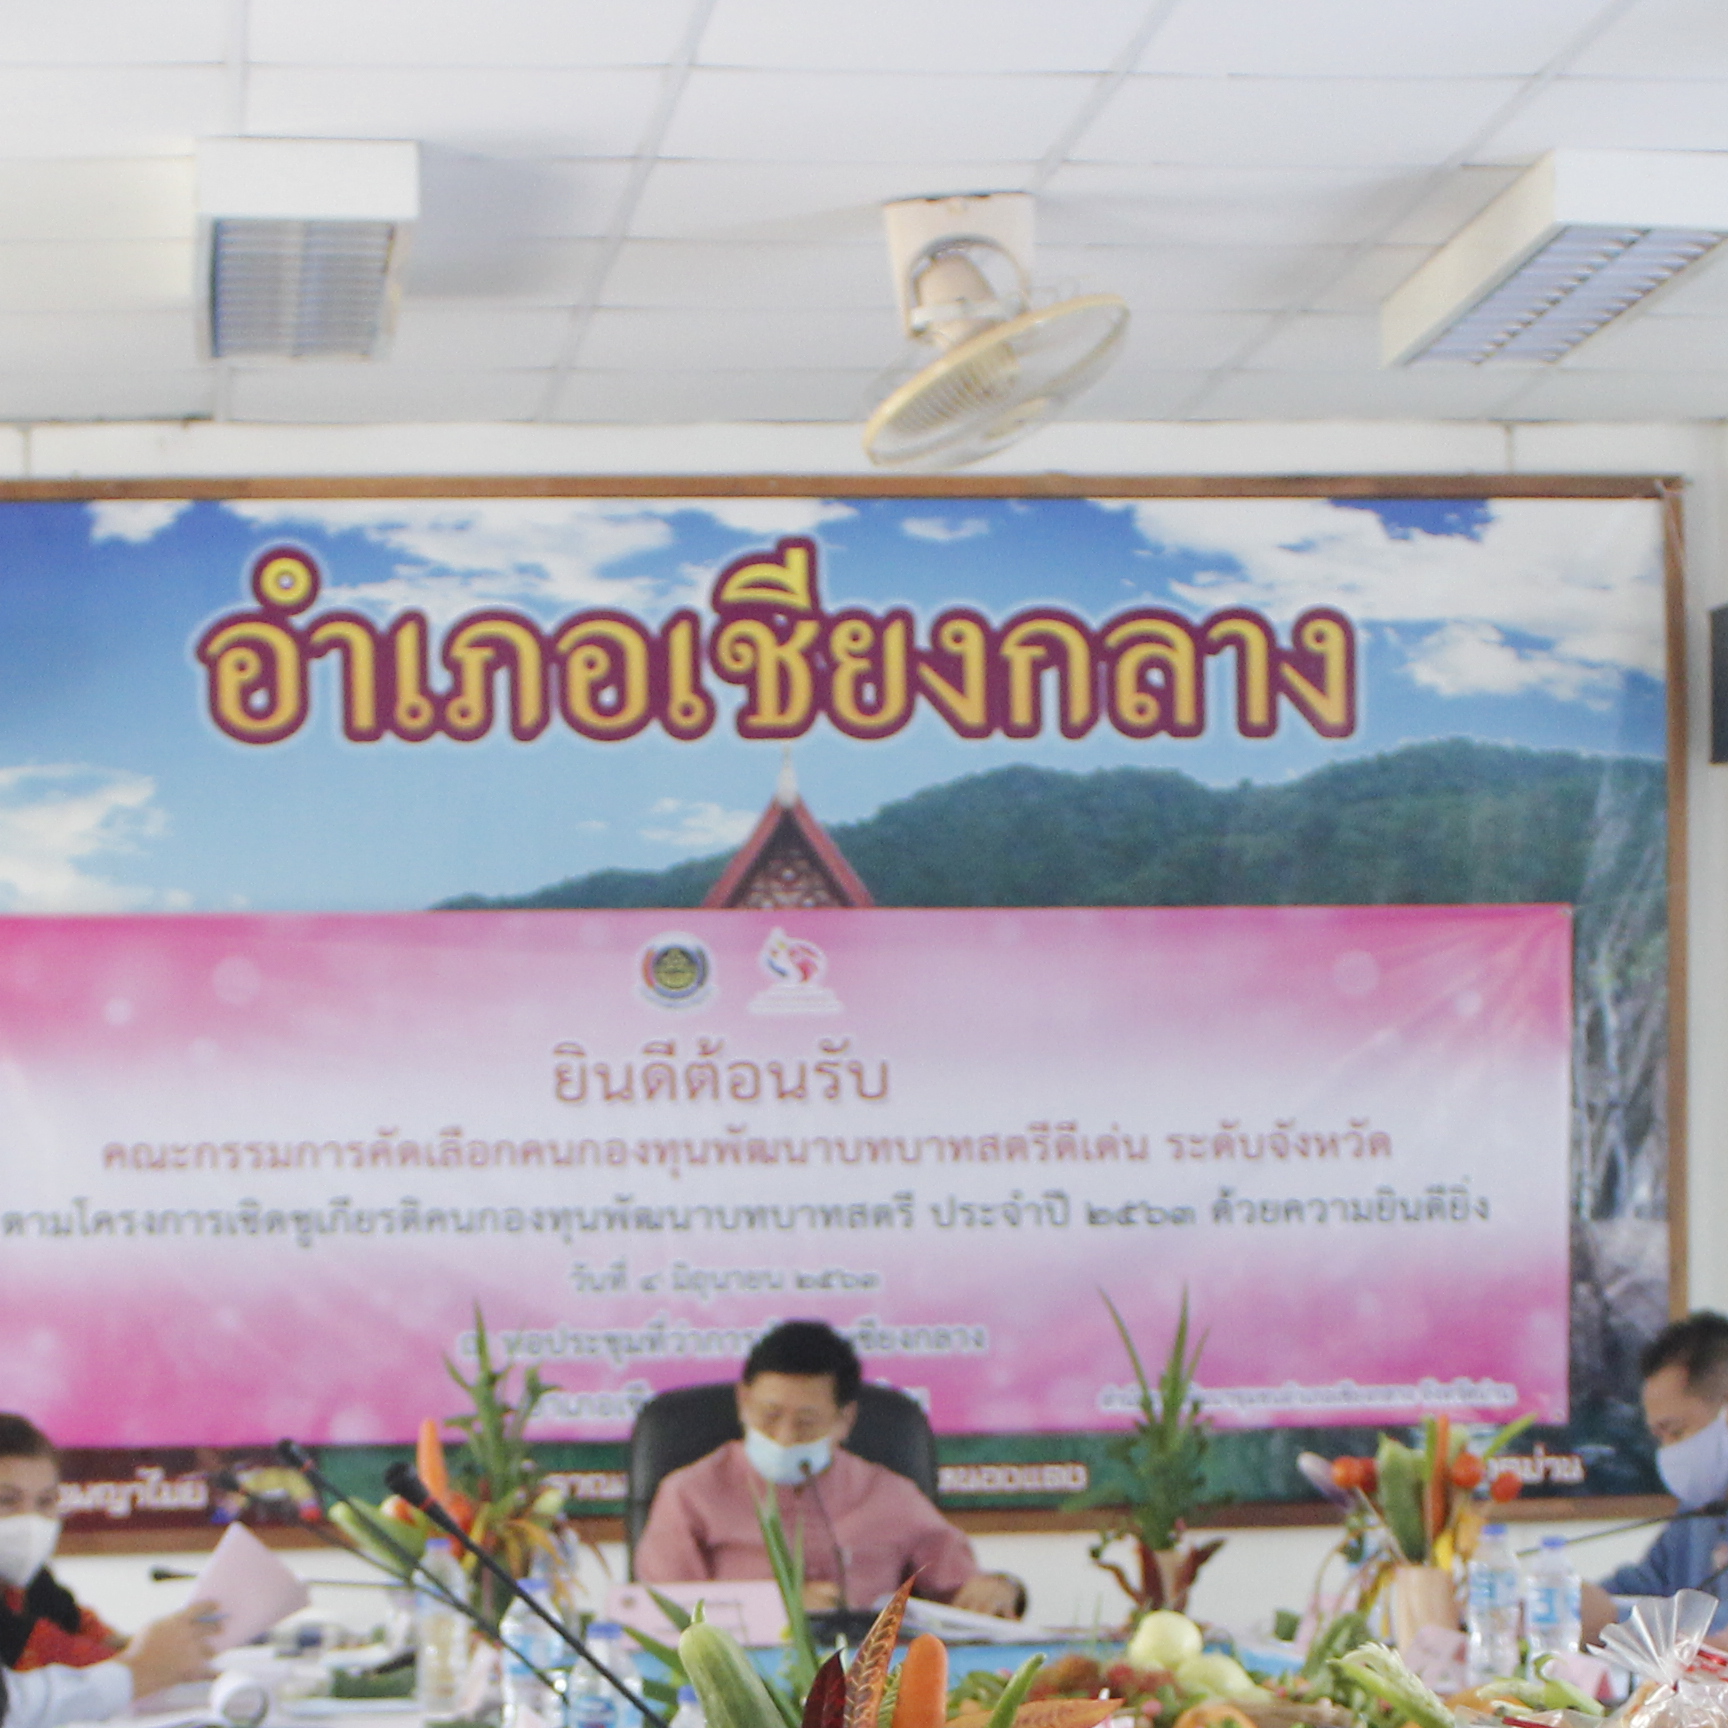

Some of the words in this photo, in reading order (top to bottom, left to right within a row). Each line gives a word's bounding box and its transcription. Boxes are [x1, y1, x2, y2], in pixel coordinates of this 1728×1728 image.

[198, 537, 1358, 744] อำเภอเชียงกลาง
[553, 1038, 890, 1104] ยินดีต้อนรับ
[1167, 1117, 1393, 1163] ระดับจังหวัด
[931, 1188, 1070, 1231] ประจำปี
